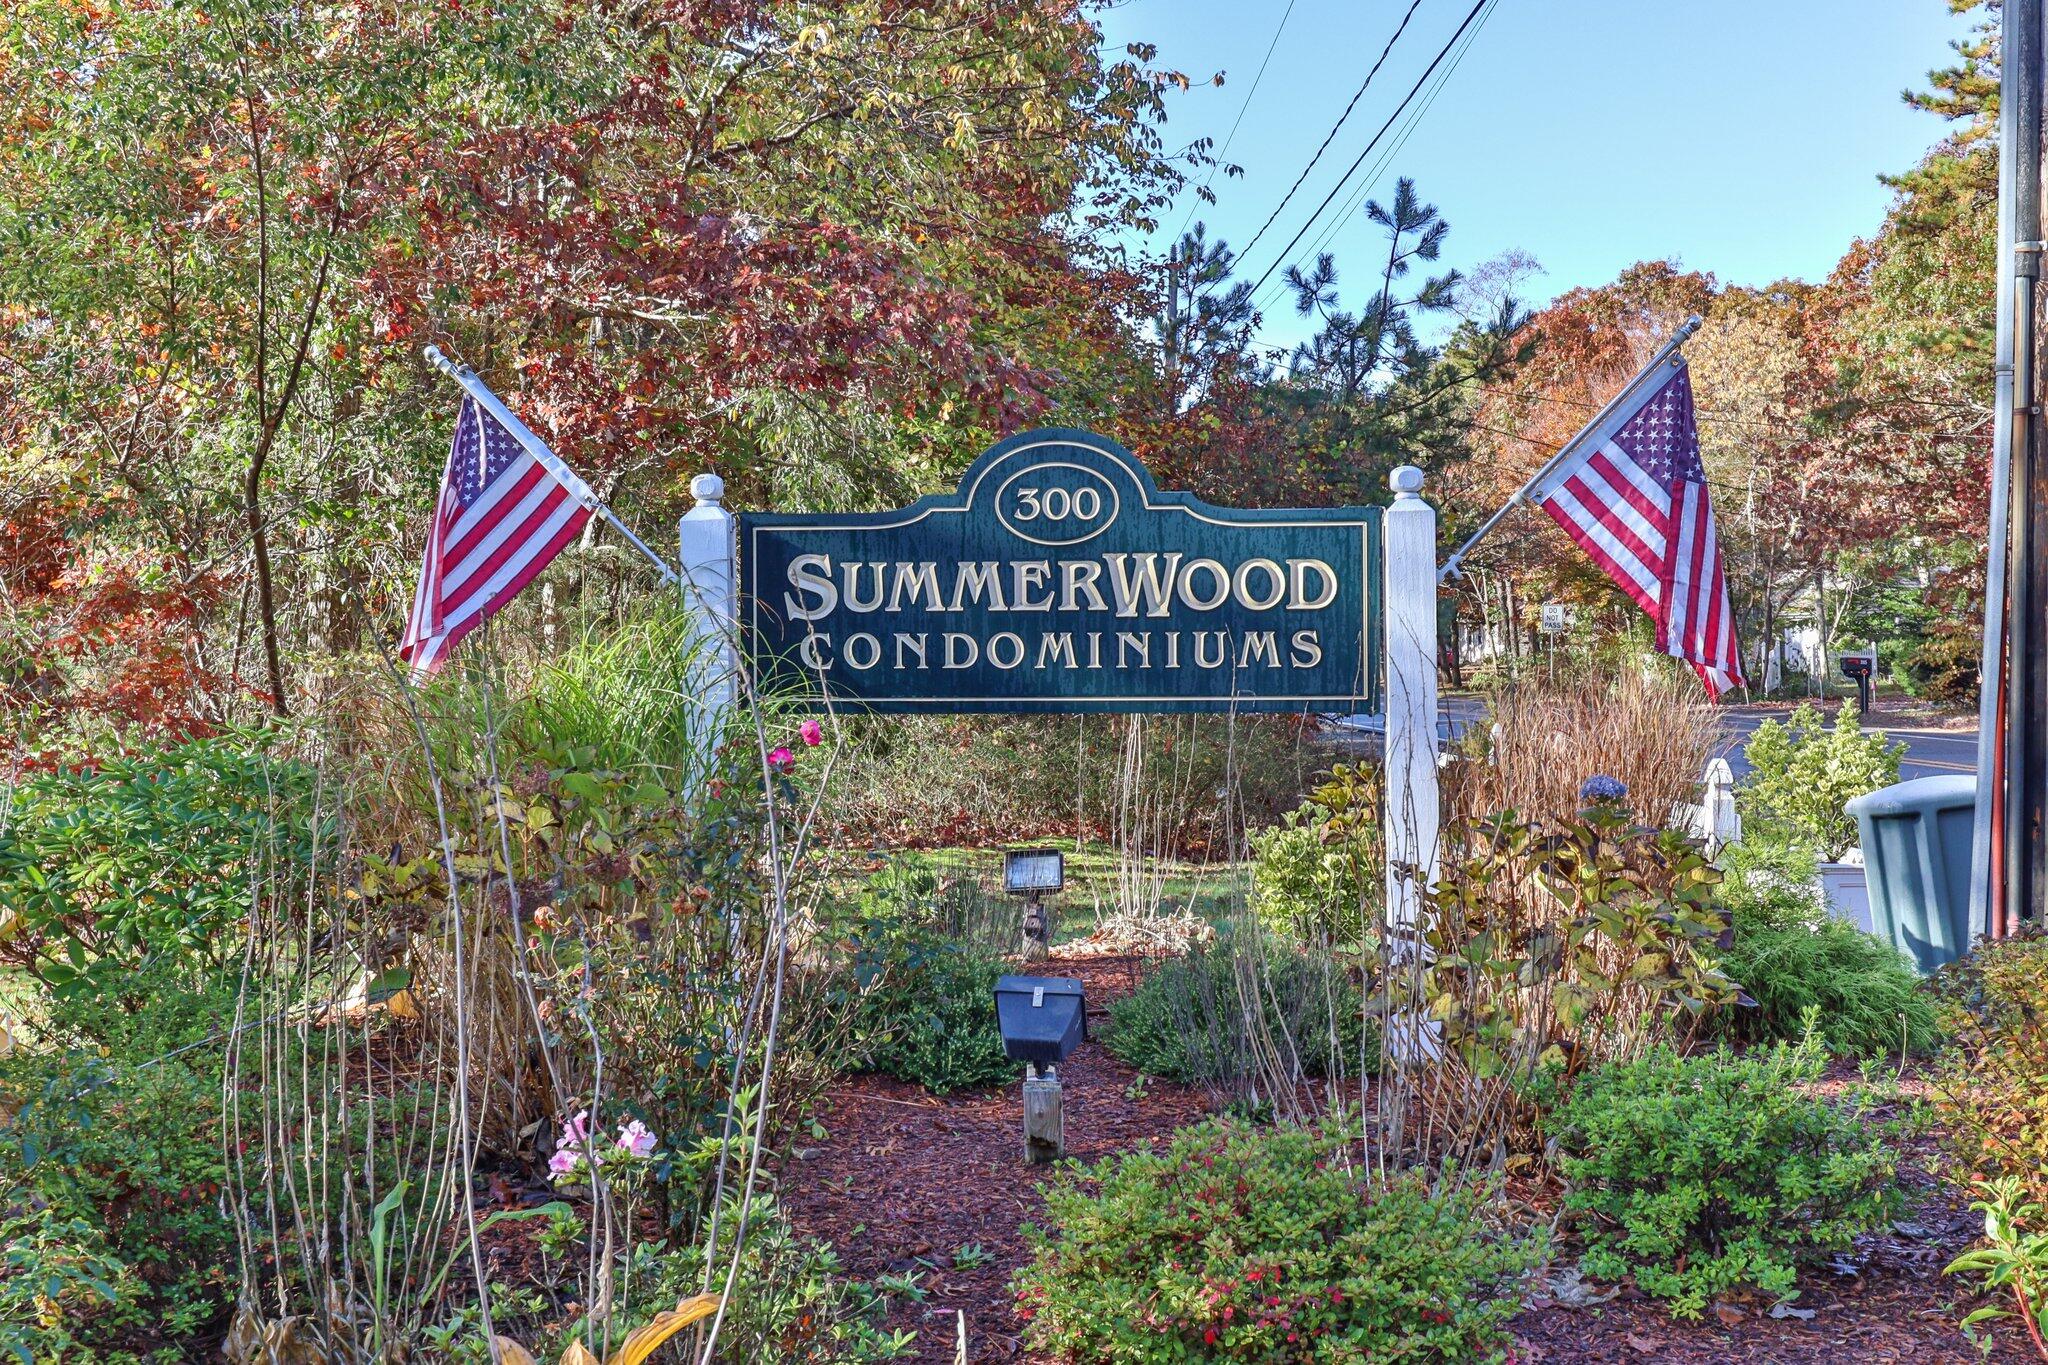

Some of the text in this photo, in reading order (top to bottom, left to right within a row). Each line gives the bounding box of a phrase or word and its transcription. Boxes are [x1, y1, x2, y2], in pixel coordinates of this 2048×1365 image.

[1013, 487, 1101, 520] 300
[783, 552, 1339, 621] SUMMERWOOD
[800, 631, 1322, 669] CONDOMINIUMS
